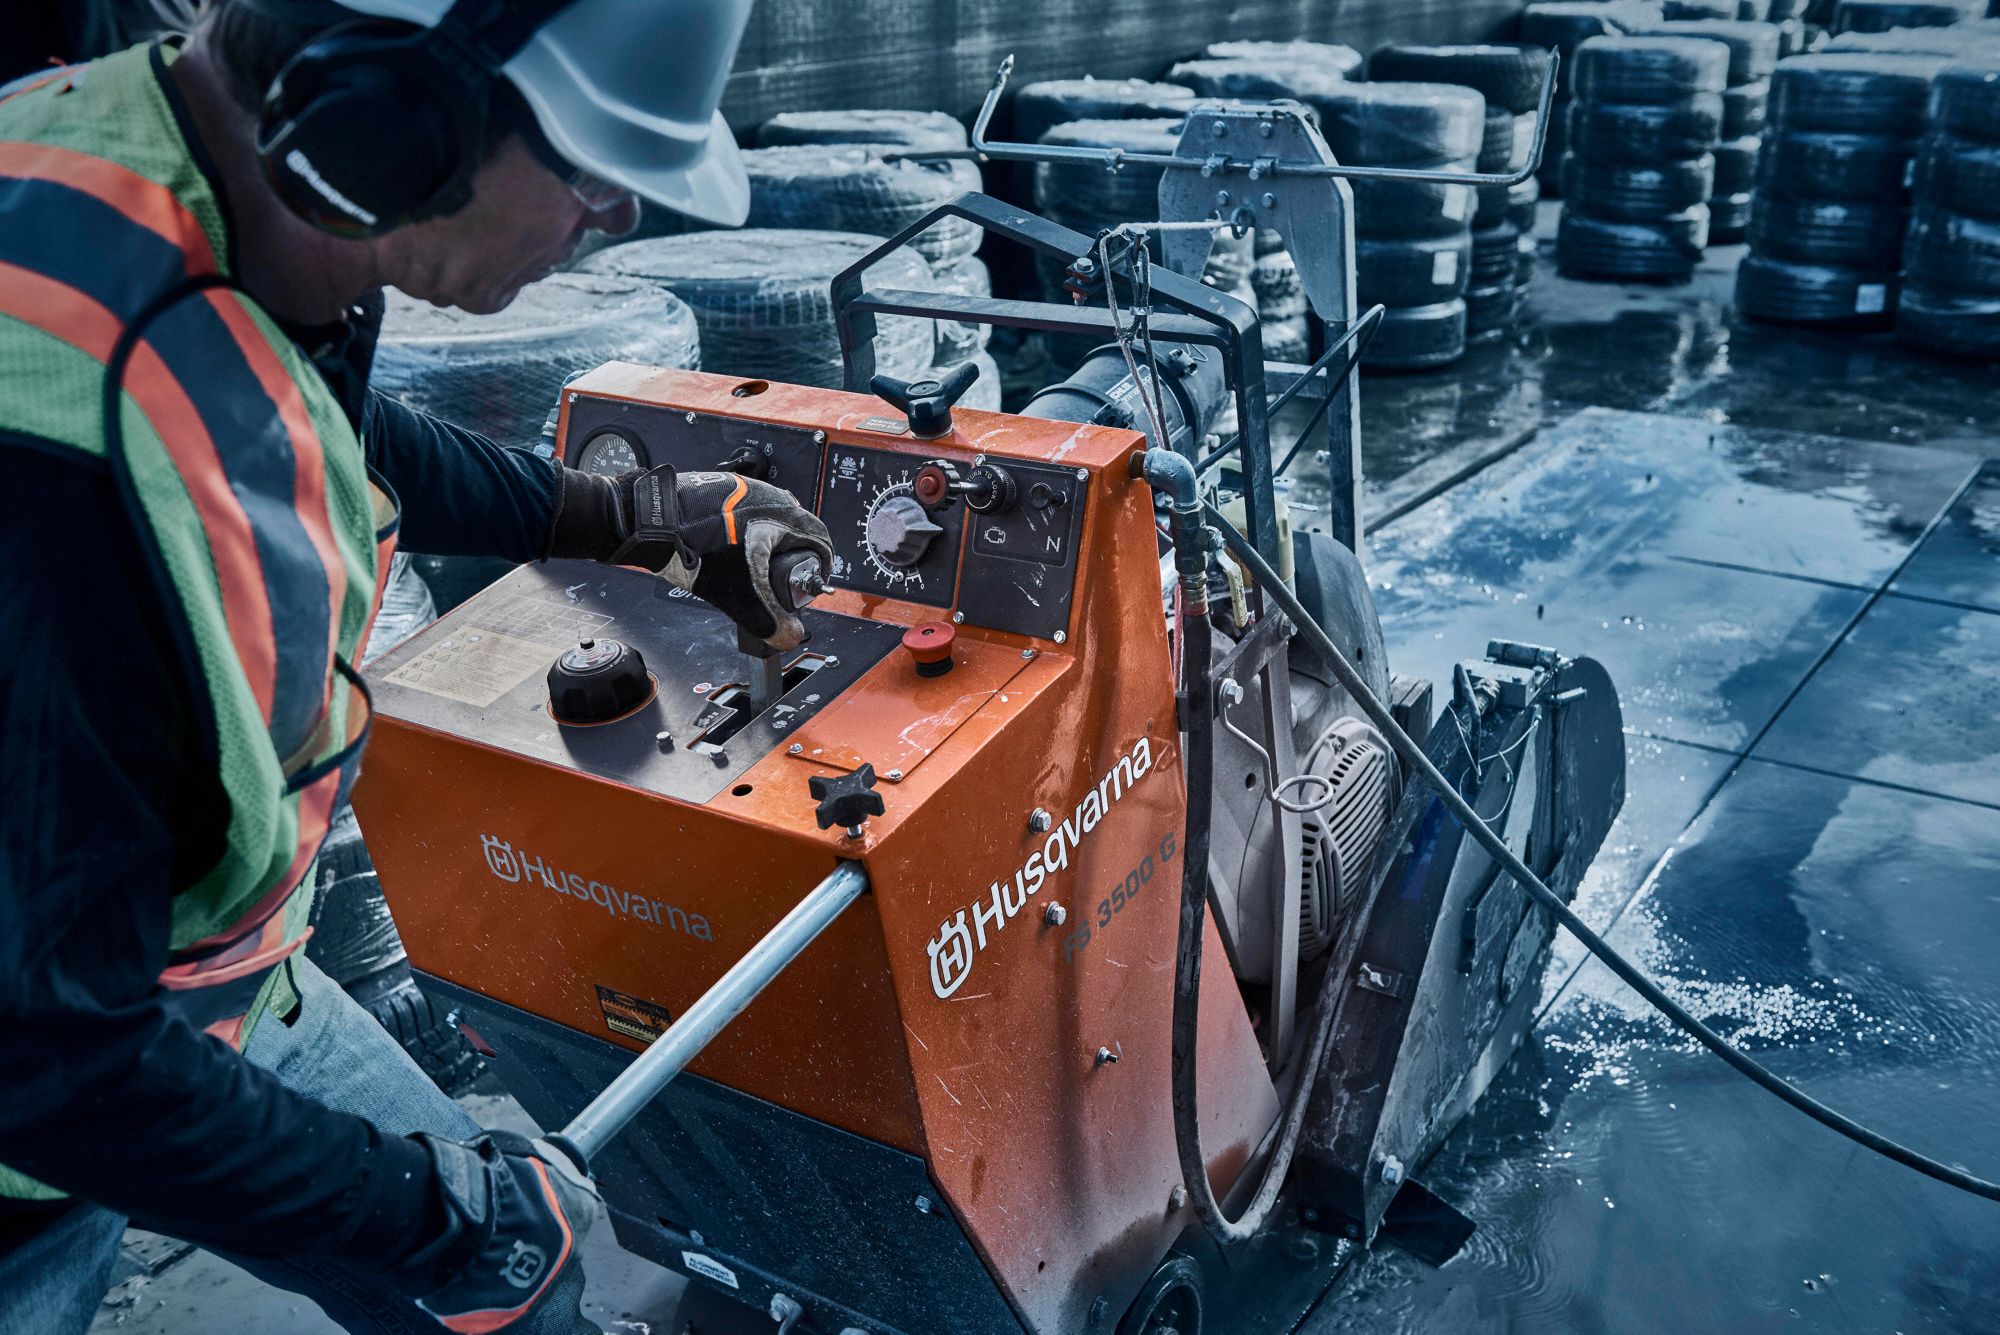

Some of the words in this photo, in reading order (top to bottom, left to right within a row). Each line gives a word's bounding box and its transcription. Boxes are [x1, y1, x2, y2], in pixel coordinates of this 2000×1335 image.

[746, 438, 759, 446] STOP
[608, 449, 615, 457] 15
[902, 469, 909, 477] 10
[967, 470, 982, 482] TURN
[984, 470, 993, 480] TO
[651, 475, 662, 517] Husqvarna
[1046, 536, 1061, 552] N
[920, 582, 925, 590] 0
[971, 736, 1151, 951] Husqvarna
[519, 850, 713, 942] Husqvarna
[1063, 920, 1092, 963] FS
[1097, 853, 1154, 929] 3500
[1158, 831, 1177, 863] G
